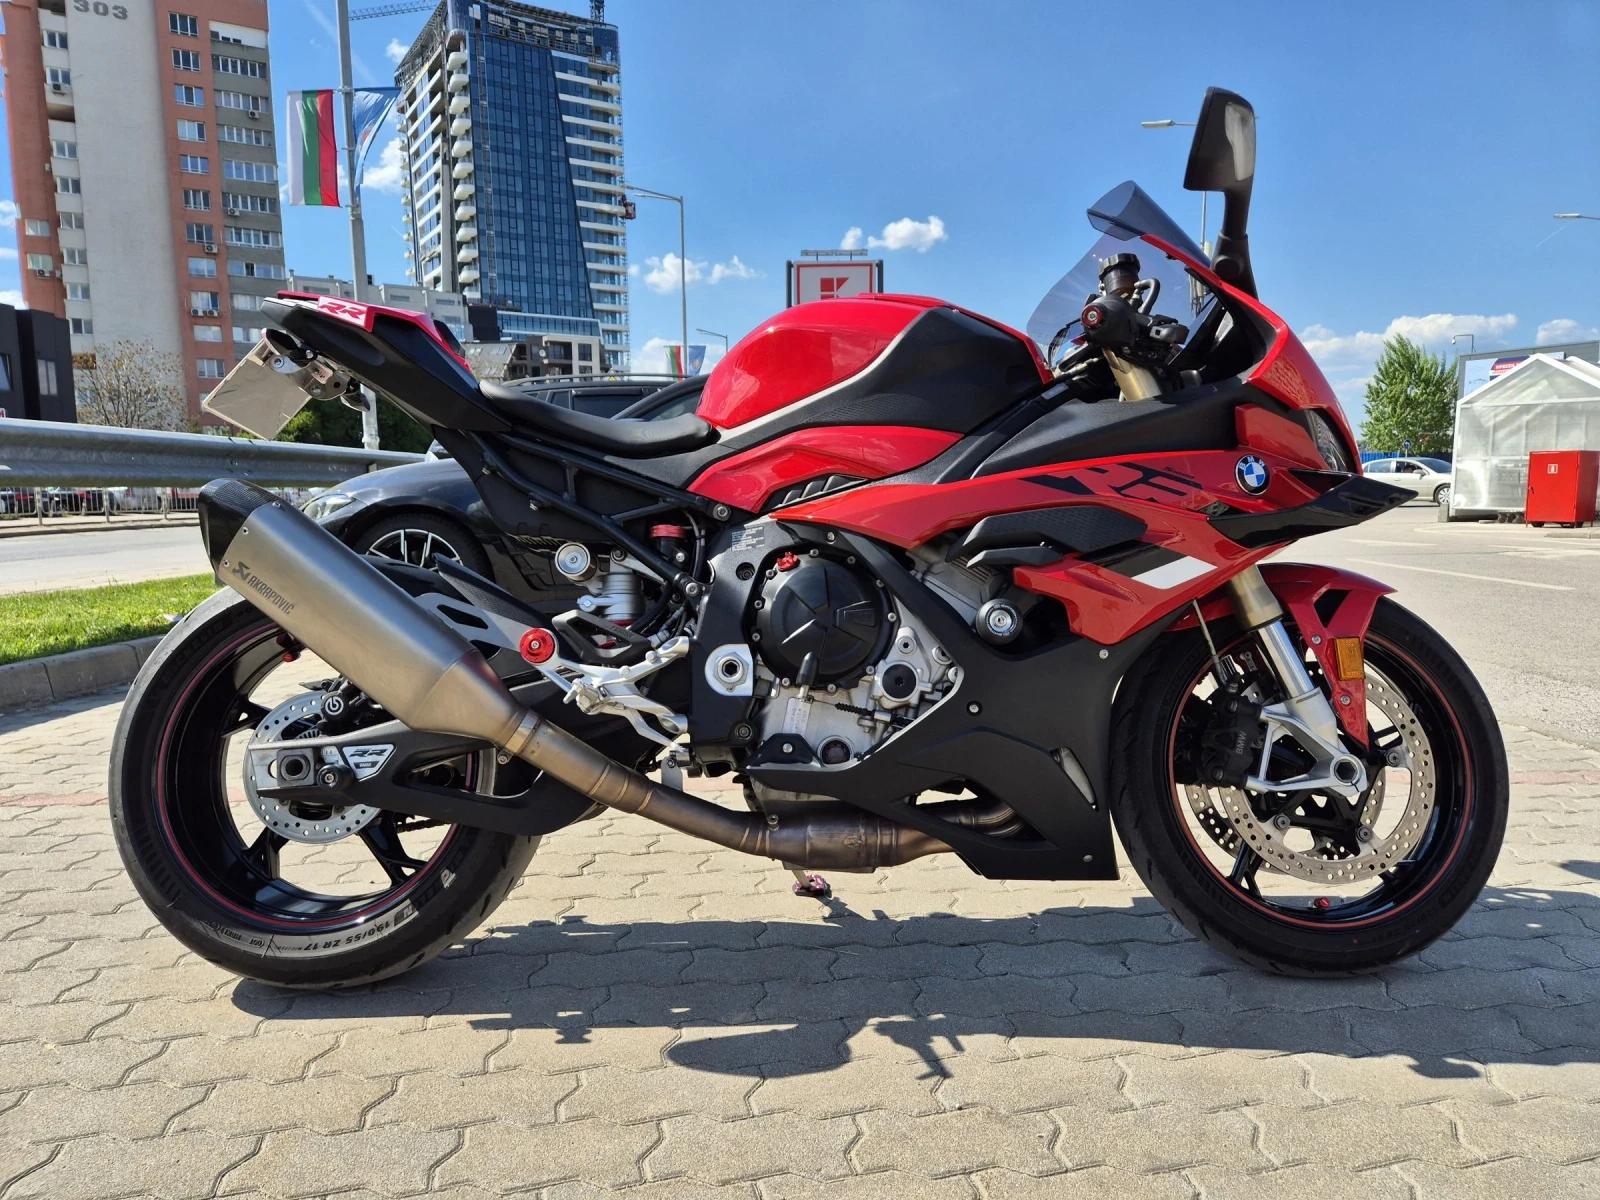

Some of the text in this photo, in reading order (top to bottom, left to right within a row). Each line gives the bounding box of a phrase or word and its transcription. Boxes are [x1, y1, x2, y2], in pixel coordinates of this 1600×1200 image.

[73, 0, 128, 20] 303
[1238, 456, 1266, 471] BMW
[1235, 731, 1247, 755] BMW
[345, 920, 391, 945] 190/55
[303, 942, 319, 951] 17
[322, 939, 342, 949] ZR
